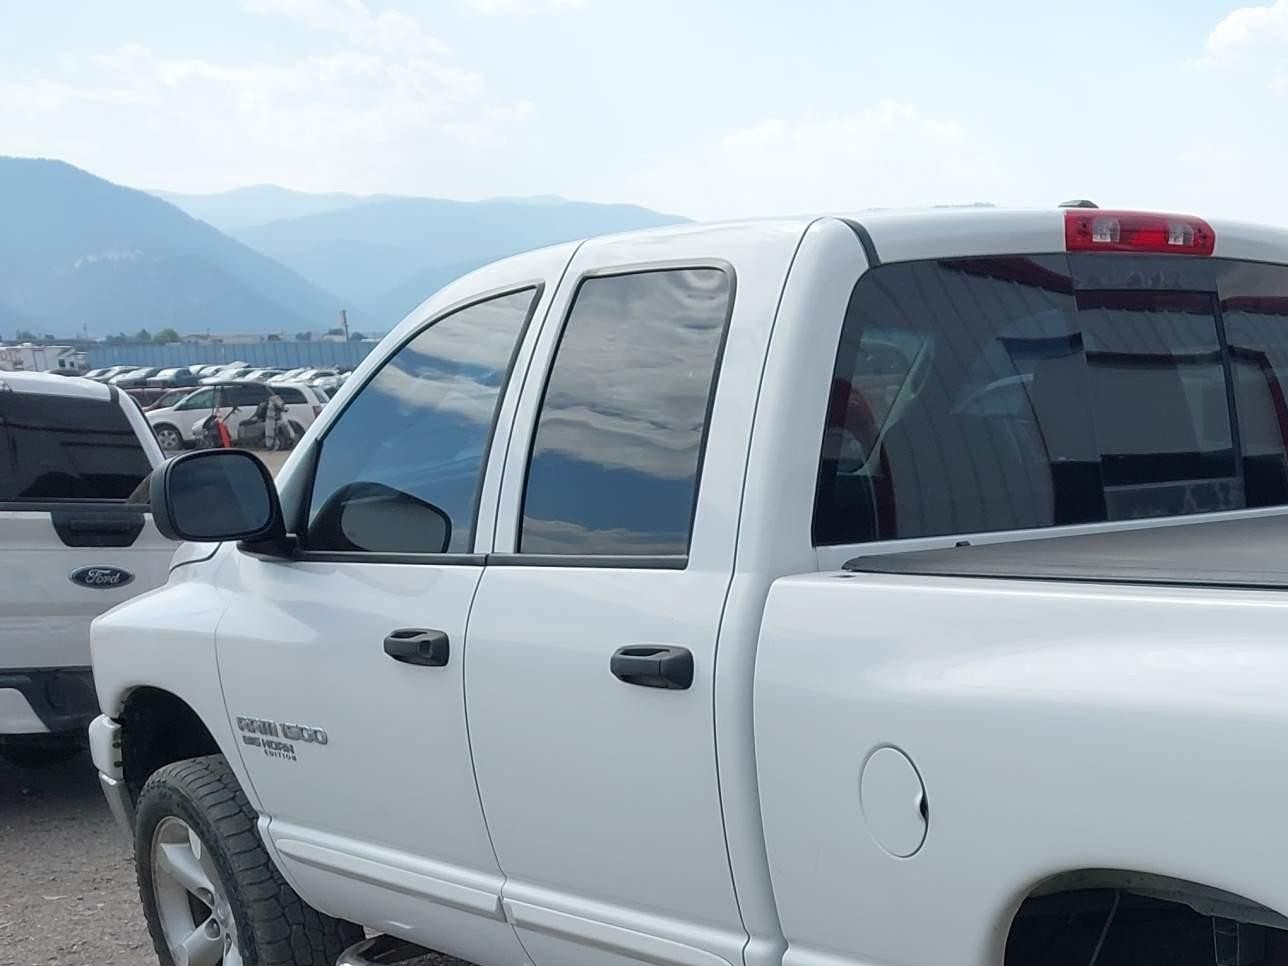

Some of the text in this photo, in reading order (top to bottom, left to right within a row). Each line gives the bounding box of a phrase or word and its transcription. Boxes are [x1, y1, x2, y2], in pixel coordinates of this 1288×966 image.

[84, 569, 121, 584] Ford
[236, 716, 328, 745] RAM 1500
[262, 738, 295, 754] HORN
[263, 749, 297, 761] EDITION
